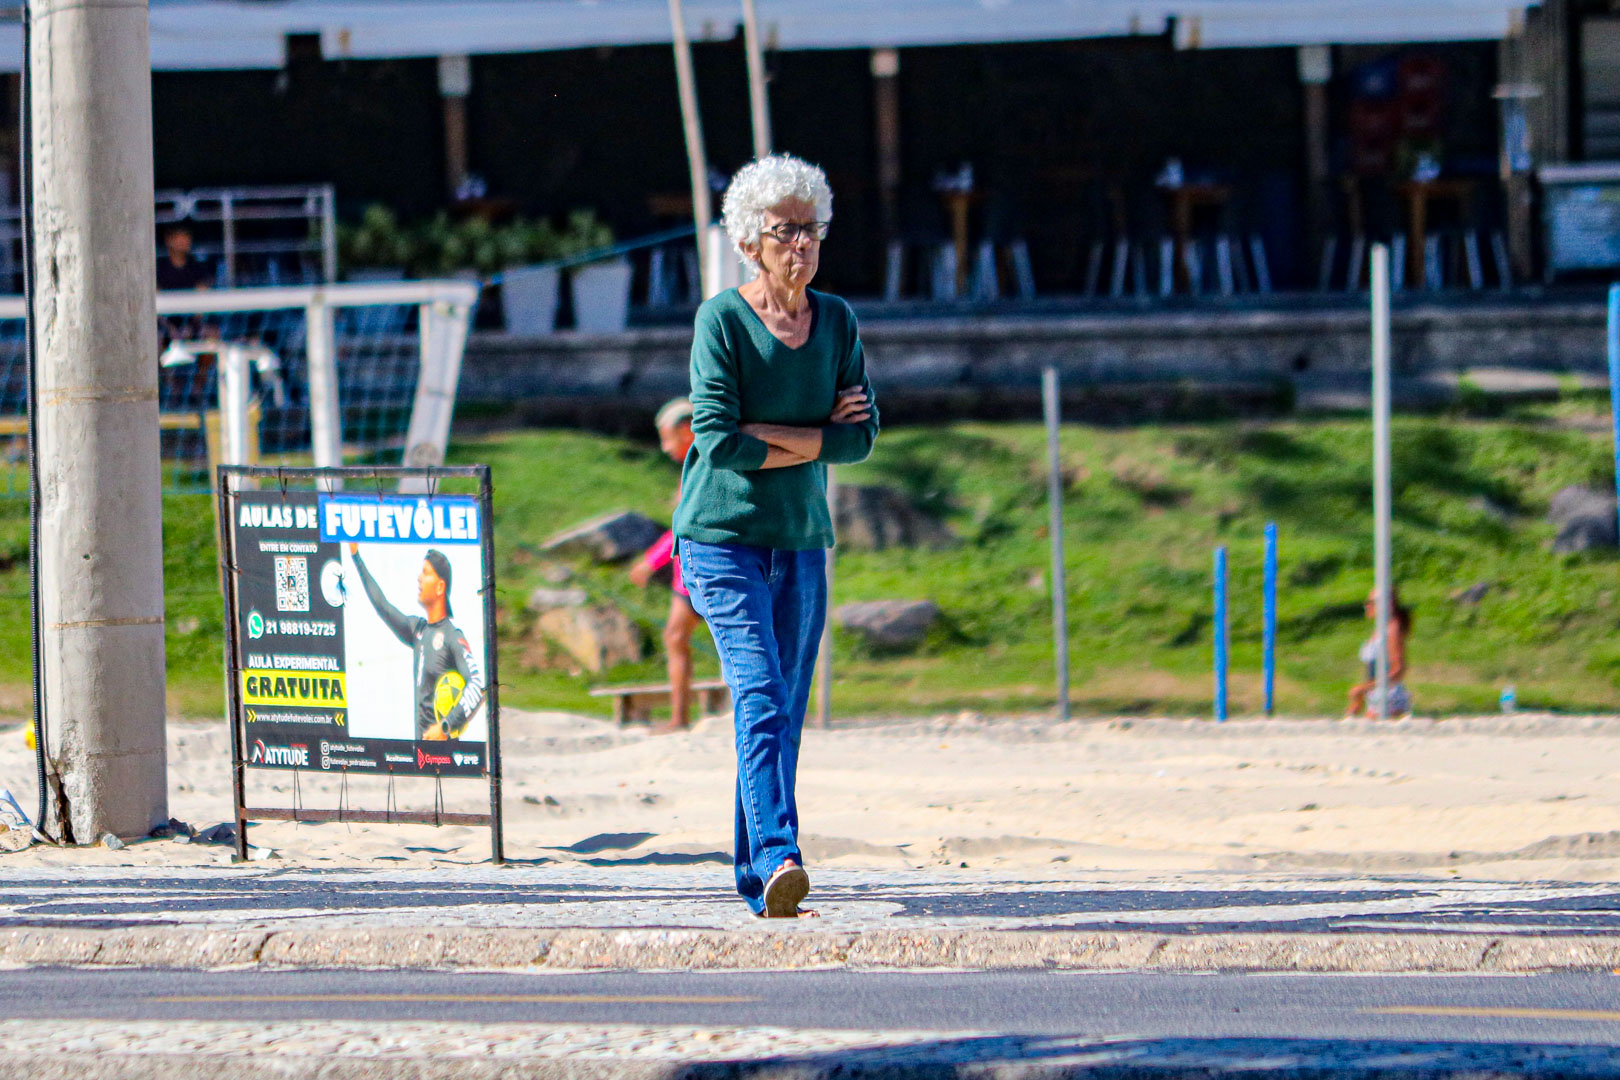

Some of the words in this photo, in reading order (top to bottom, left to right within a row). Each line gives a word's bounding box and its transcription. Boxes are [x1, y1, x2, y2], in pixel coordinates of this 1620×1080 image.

[240, 505, 293, 529] AULAS
[295, 505, 318, 529] DE
[325, 499, 478, 540] FUTEVÔLEI
[259, 542, 279, 552] ENTRE
[280, 542, 289, 552] EM
[290, 542, 318, 553] CONTATO
[266, 621, 277, 635] 21
[280, 621, 336, 636] 98819-2725
[248, 655, 273, 668] AULA
[274, 656, 339, 671] EXPERIMENTAL
[246, 676, 344, 700] GRATUITA
[265, 748, 309, 765] ATYTUDE
